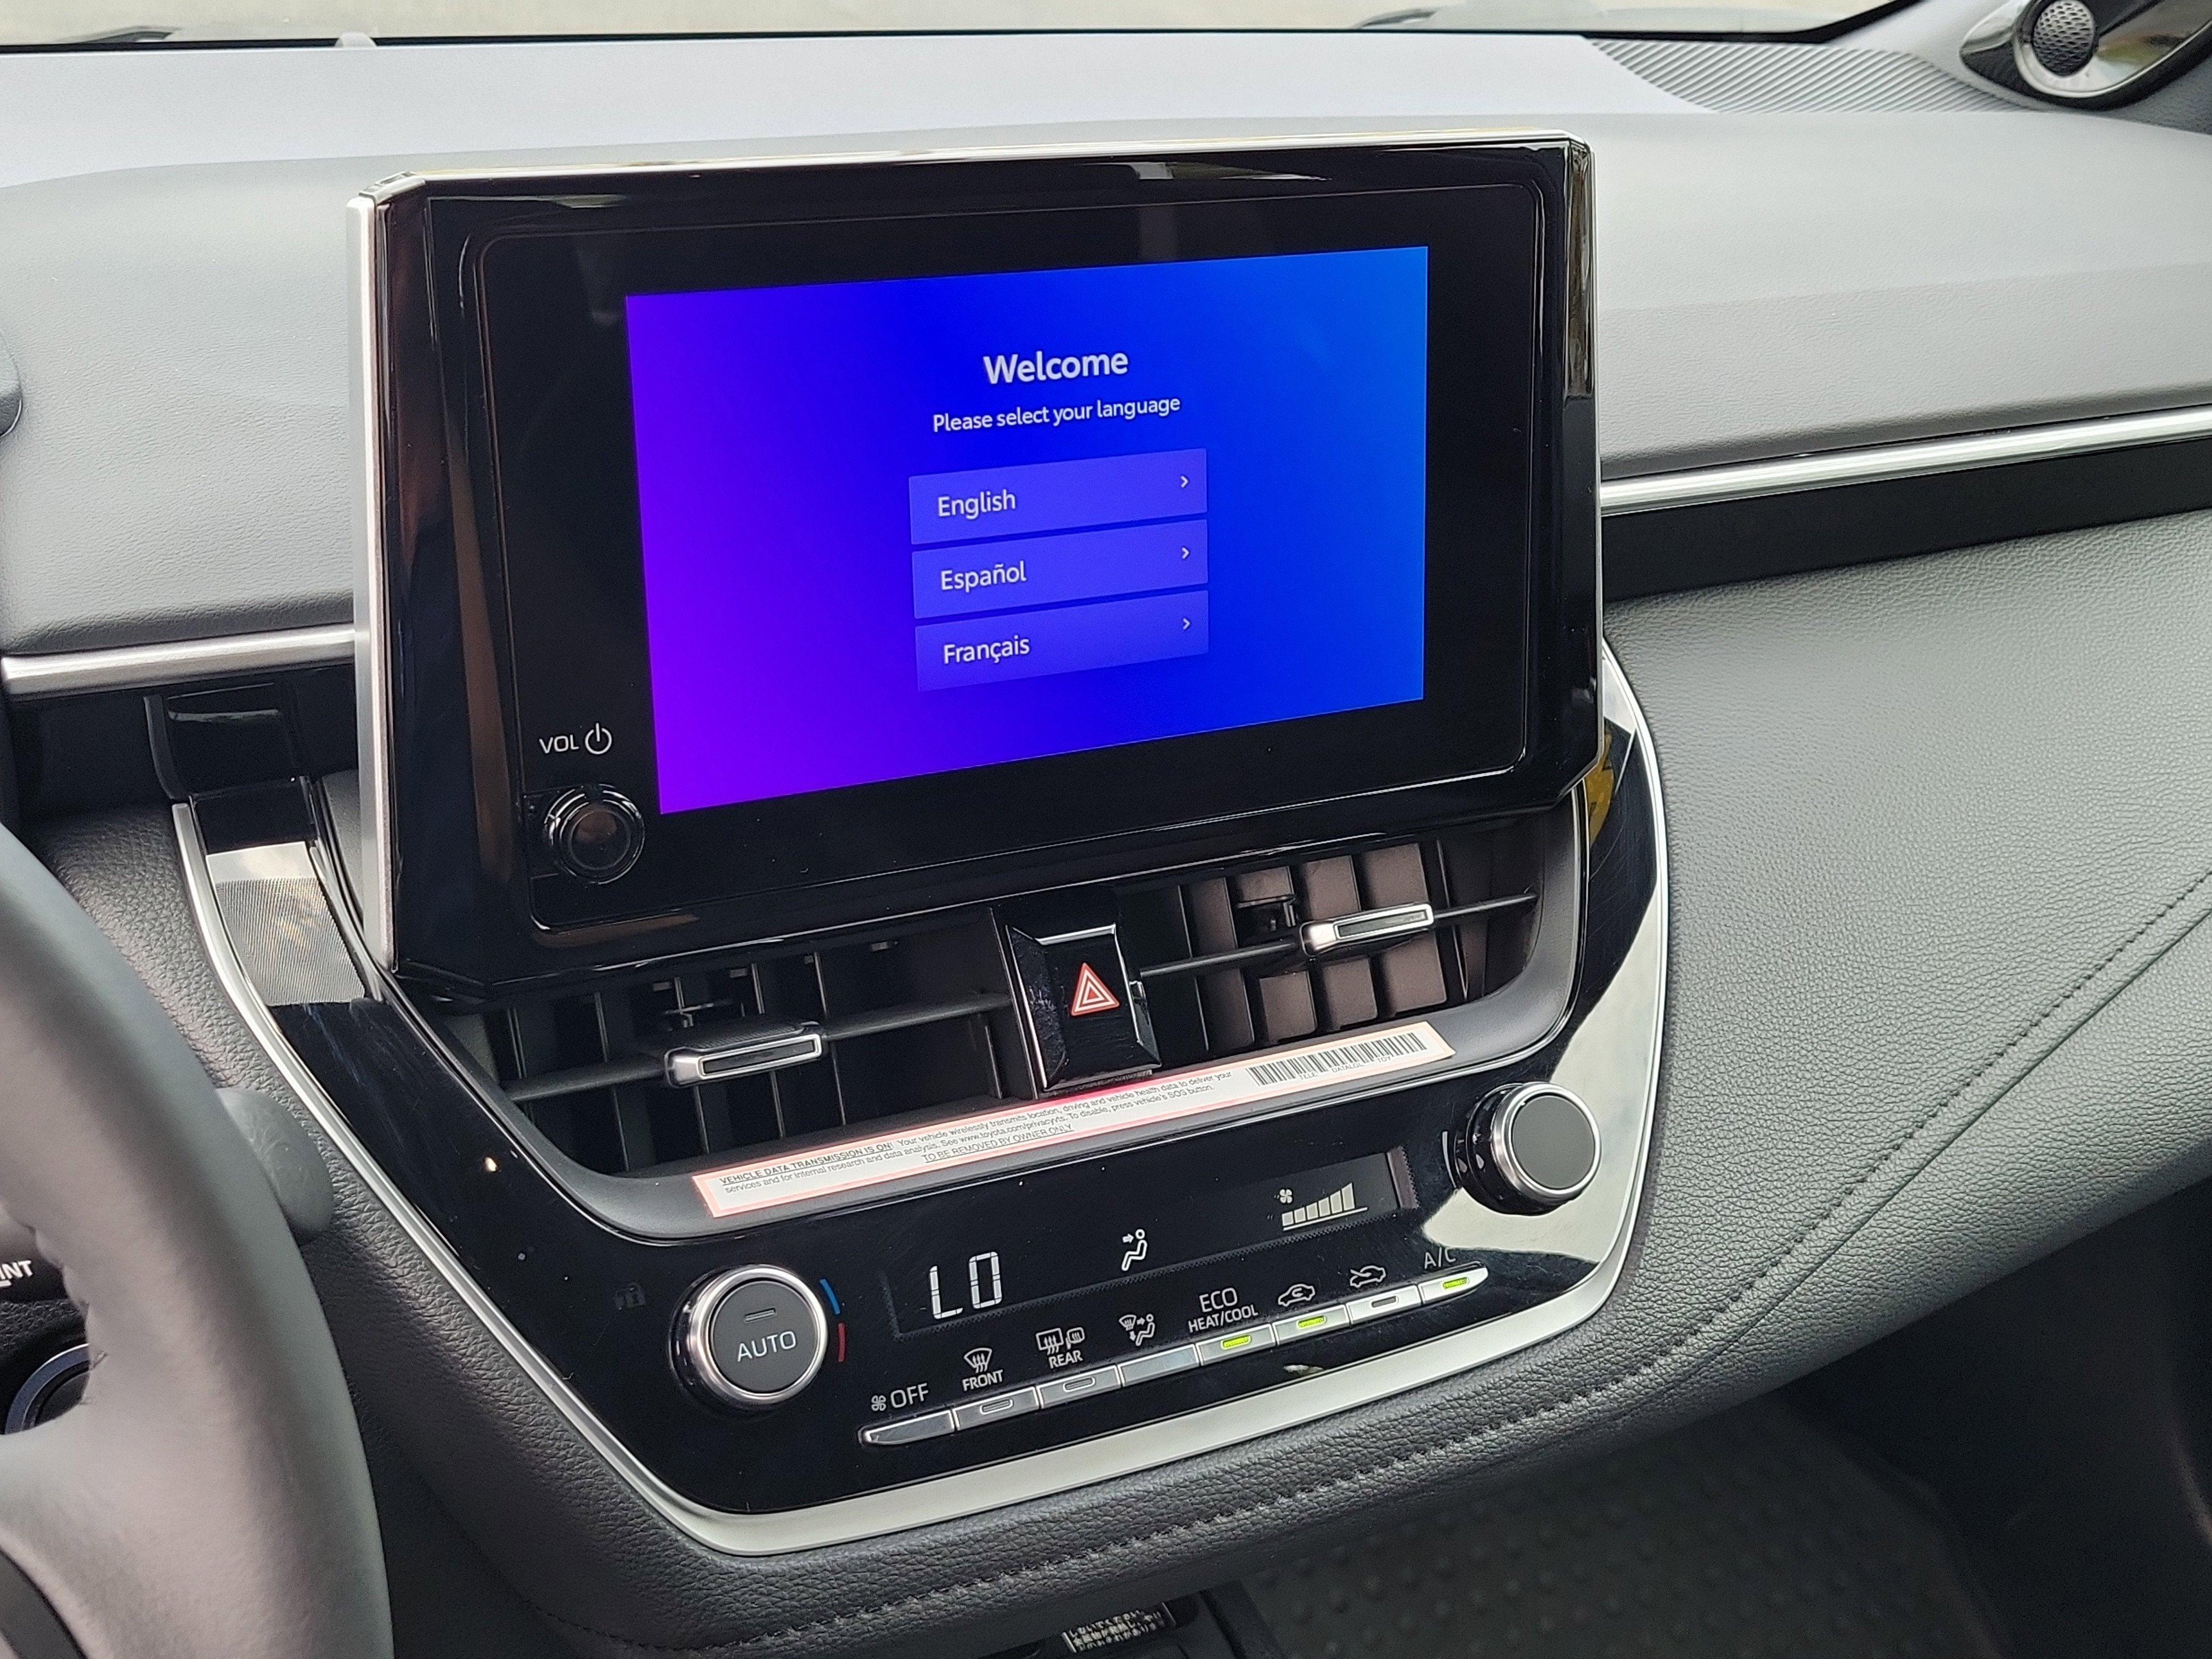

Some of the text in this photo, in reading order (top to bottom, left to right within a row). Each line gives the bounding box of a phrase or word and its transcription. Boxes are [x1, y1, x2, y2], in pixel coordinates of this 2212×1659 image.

[983, 350, 1129, 385] Welcome
[933, 397, 1181, 433] Please select your language
[937, 489, 1016, 520] English
[940, 560, 1027, 592] Español
[943, 634, 1030, 664] Français
[539, 734, 579, 754] VOL
[719, 1170, 761, 1184] VEHICLE
[764, 1165, 790, 1178] DATA
[791, 1148, 863, 1170] TRANSMISSION
[865, 1146, 874, 1154] IS
[897, 1138, 917, 1148] Your
[919, 1131, 948, 1142] vehicle
[949, 1122, 989, 1136] wirelessly
[989, 1115, 1027, 1127] transmits
[1028, 1107, 1062, 1119] location,
[1063, 1101, 1090, 1113] driving
[1091, 1097, 1105, 1105] and
[1107, 1091, 1134, 1102] vehicle
[1135, 1086, 1160, 1098] health
[1161, 1083, 1178, 1091] data
[1188, 1075, 1214, 1086] deliver
[1215, 1071, 1233, 1083] your
[725, 1180, 761, 1194] services
[763, 1176, 780, 1185] and
[781, 1173, 793, 1182] for
[795, 1166, 827, 1179] internal
[828, 1159, 865, 1172] research
[867, 1154, 883, 1163] and
[884, 1150, 902, 1160] data
[904, 1143, 940, 1156] analysis.
[942, 1139, 958, 1147] See
[1069, 1111, 1079, 1120] To
[1080, 1106, 1111, 1118] disable,
[1113, 1102, 1134, 1113] press
[1134, 1093, 1168, 1106] vehicle's
[1169, 1089, 1187, 1098] SOS
[922, 1124, 1073, 1163] TO BE REMOVED BY OWNER ONLY
[1424, 1246, 1457, 1269] A/C
[929, 1251, 1002, 1319] LO
[1199, 1287, 1238, 1313] ECO
[1188, 1304, 1259, 1333] HEAT/COOL
[737, 1330, 797, 1362] AUTO
[1048, 1350, 1083, 1369] REAR
[962, 1369, 1003, 1391] FRONT
[890, 1383, 929, 1409] OFF
